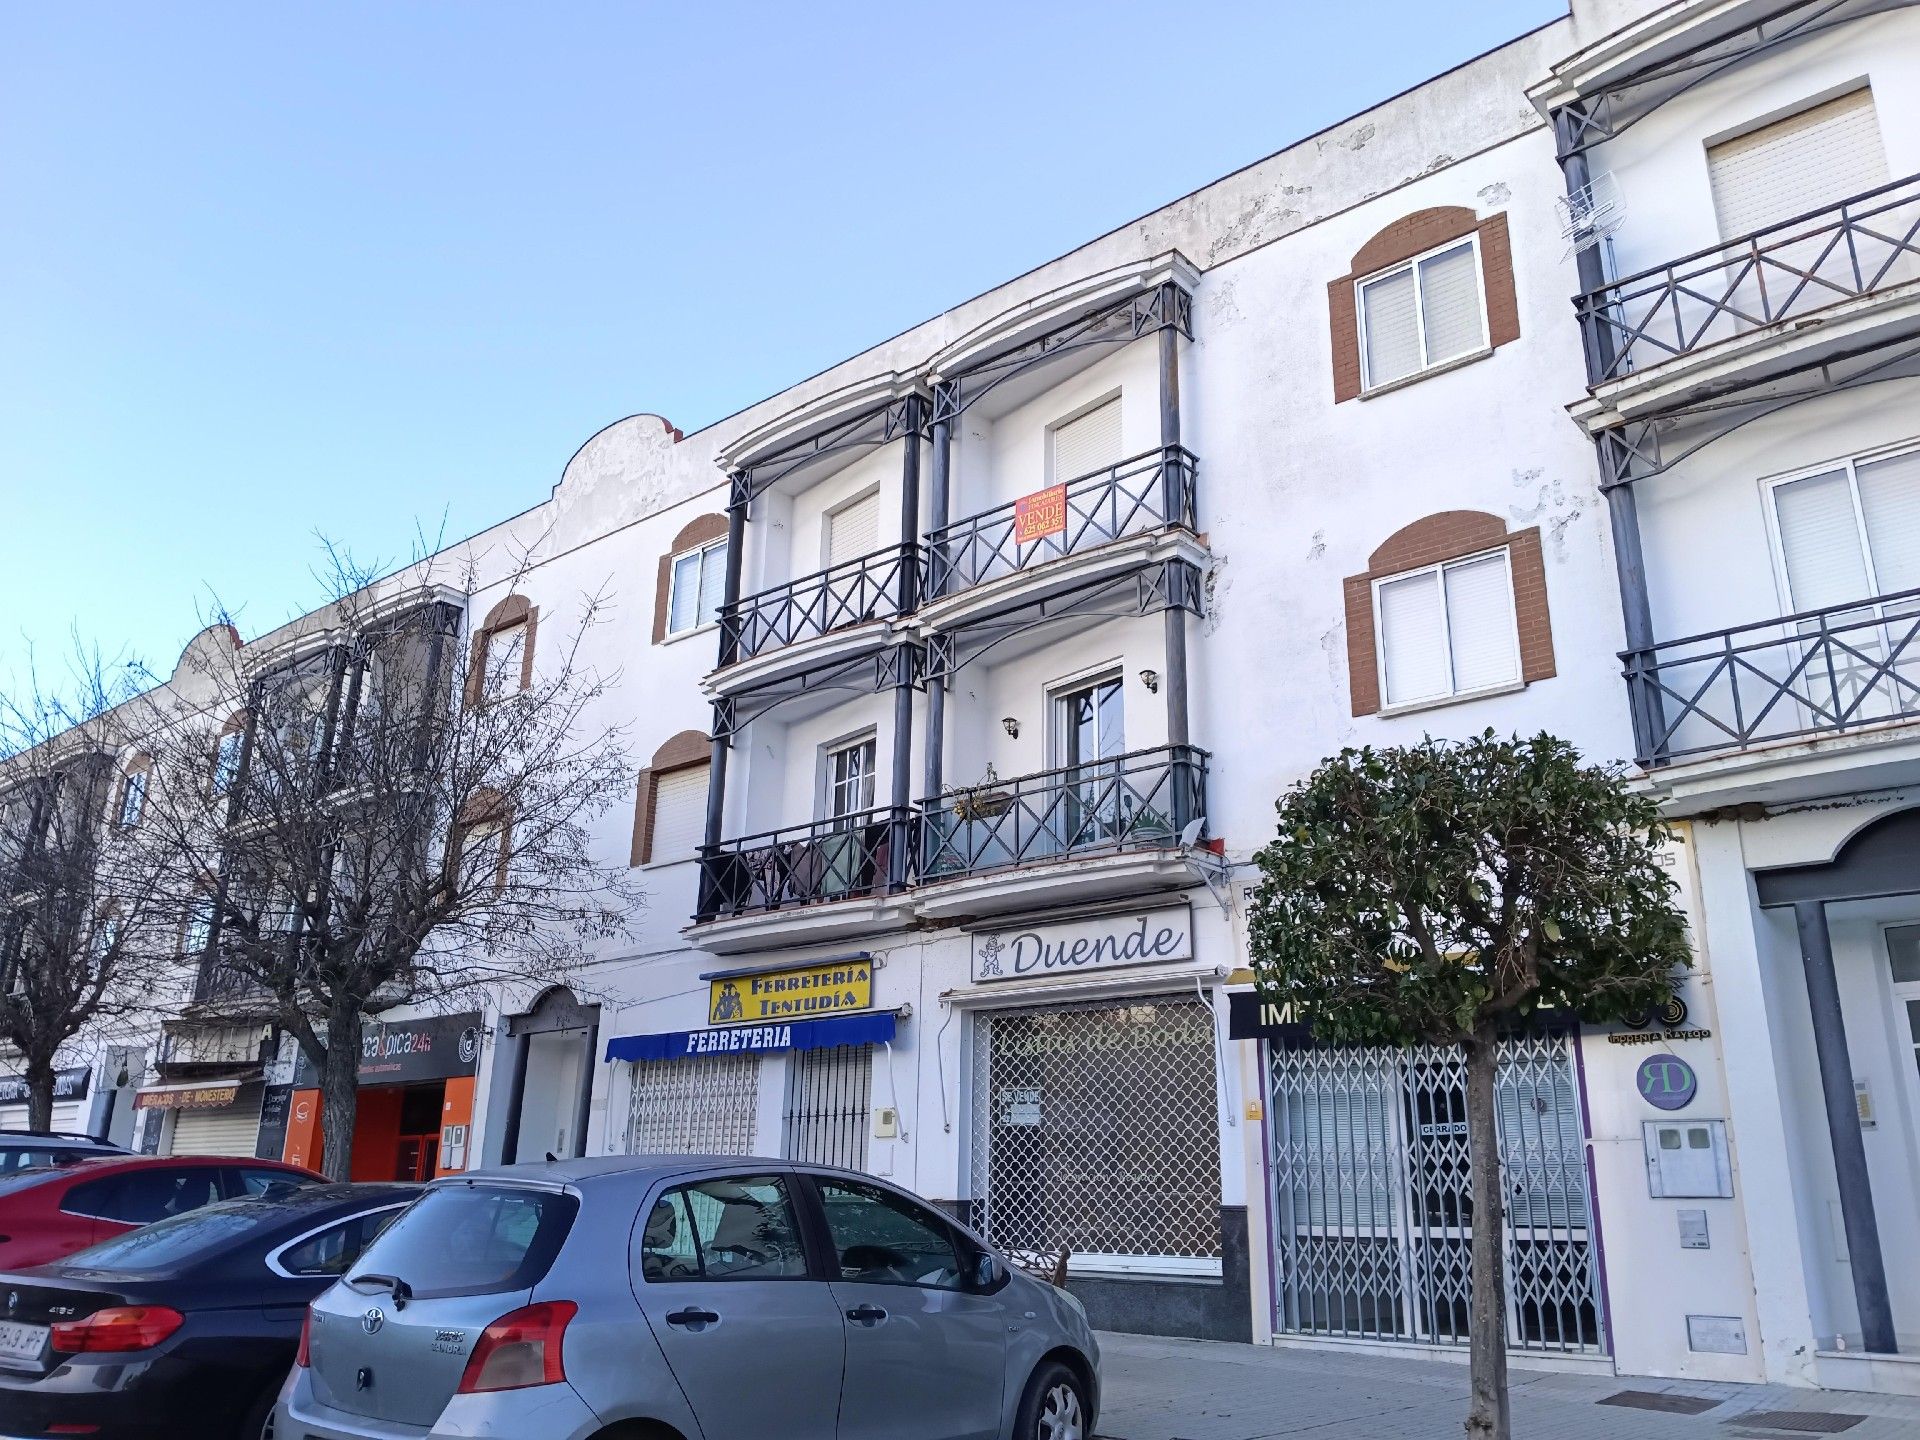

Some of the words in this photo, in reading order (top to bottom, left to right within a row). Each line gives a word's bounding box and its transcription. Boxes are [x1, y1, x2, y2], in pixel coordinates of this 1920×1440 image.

[1018, 502, 1063, 528] VENDE
[1010, 916, 1185, 974] Duende
[751, 967, 869, 995] FERRETERÍA
[759, 990, 858, 1016] TENTUDÍA
[686, 1025, 791, 1053] FERRETERIA
[435, 1329, 466, 1343] YARIS
